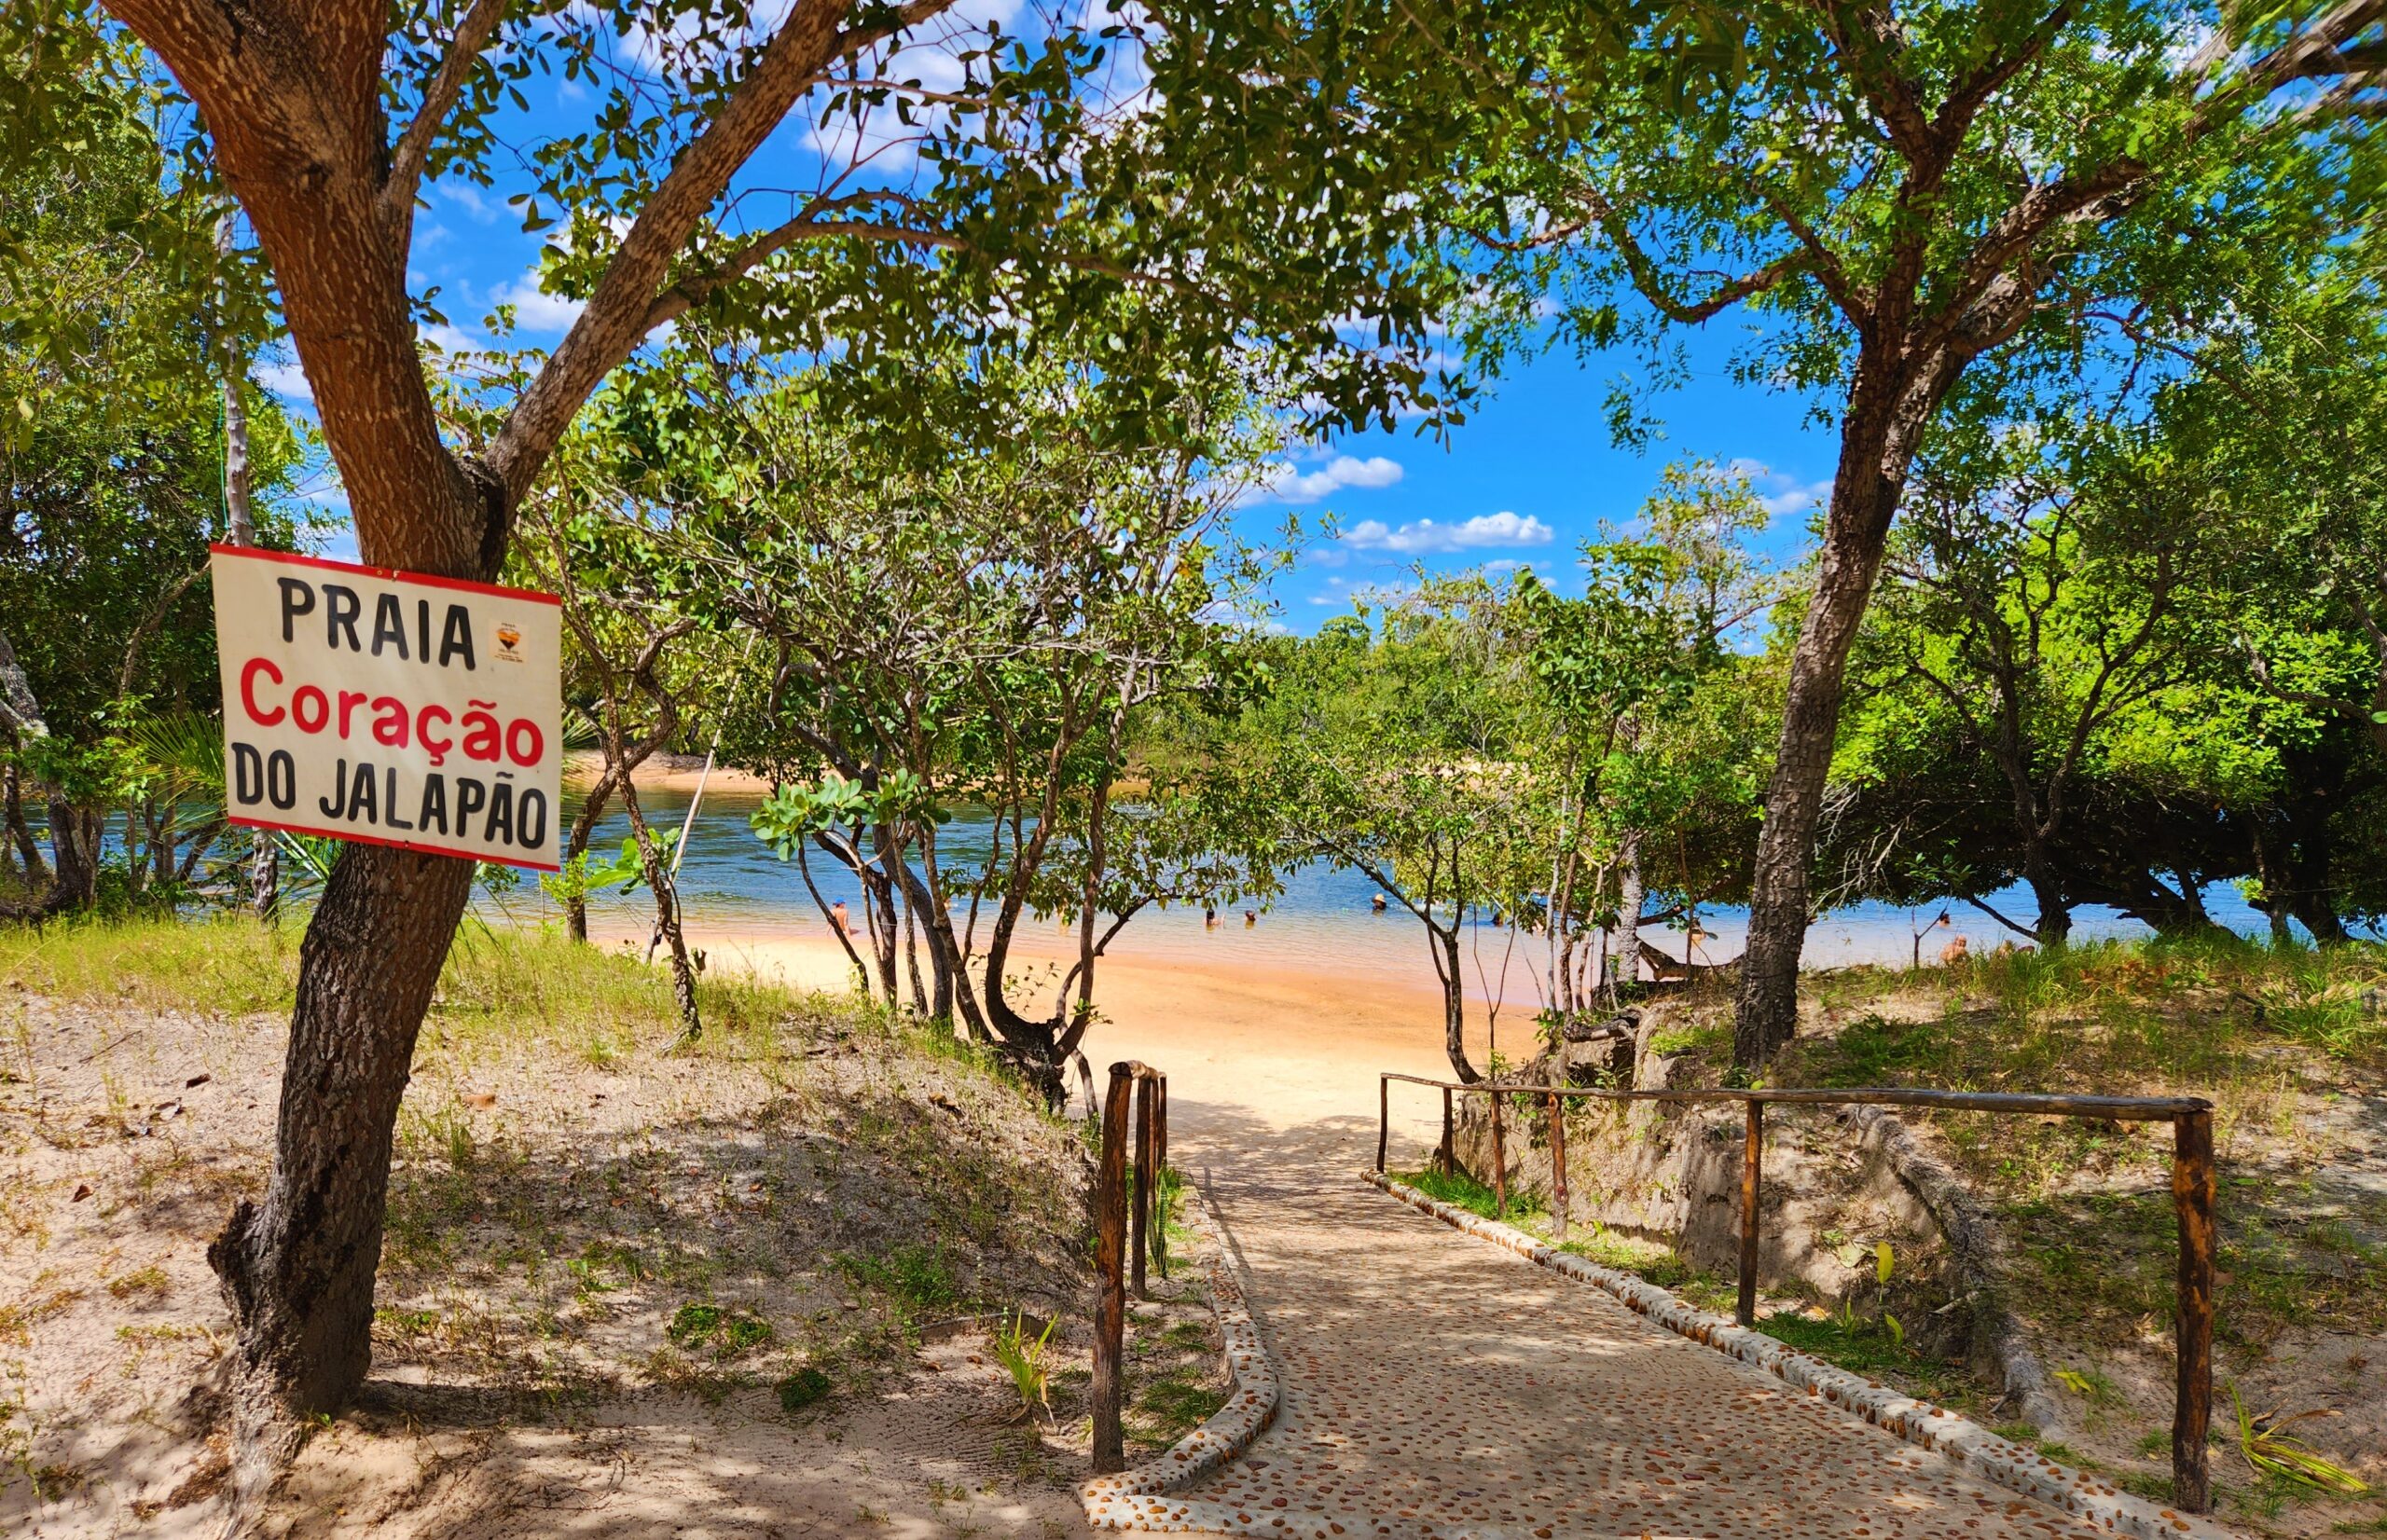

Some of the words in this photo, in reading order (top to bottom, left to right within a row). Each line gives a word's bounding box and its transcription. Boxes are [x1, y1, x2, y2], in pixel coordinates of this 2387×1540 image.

[277, 577, 476, 671] PRAIA
[241, 657, 545, 768] Coração
[231, 742, 297, 811] DO
[318, 758, 547, 850] JALAPÃO
